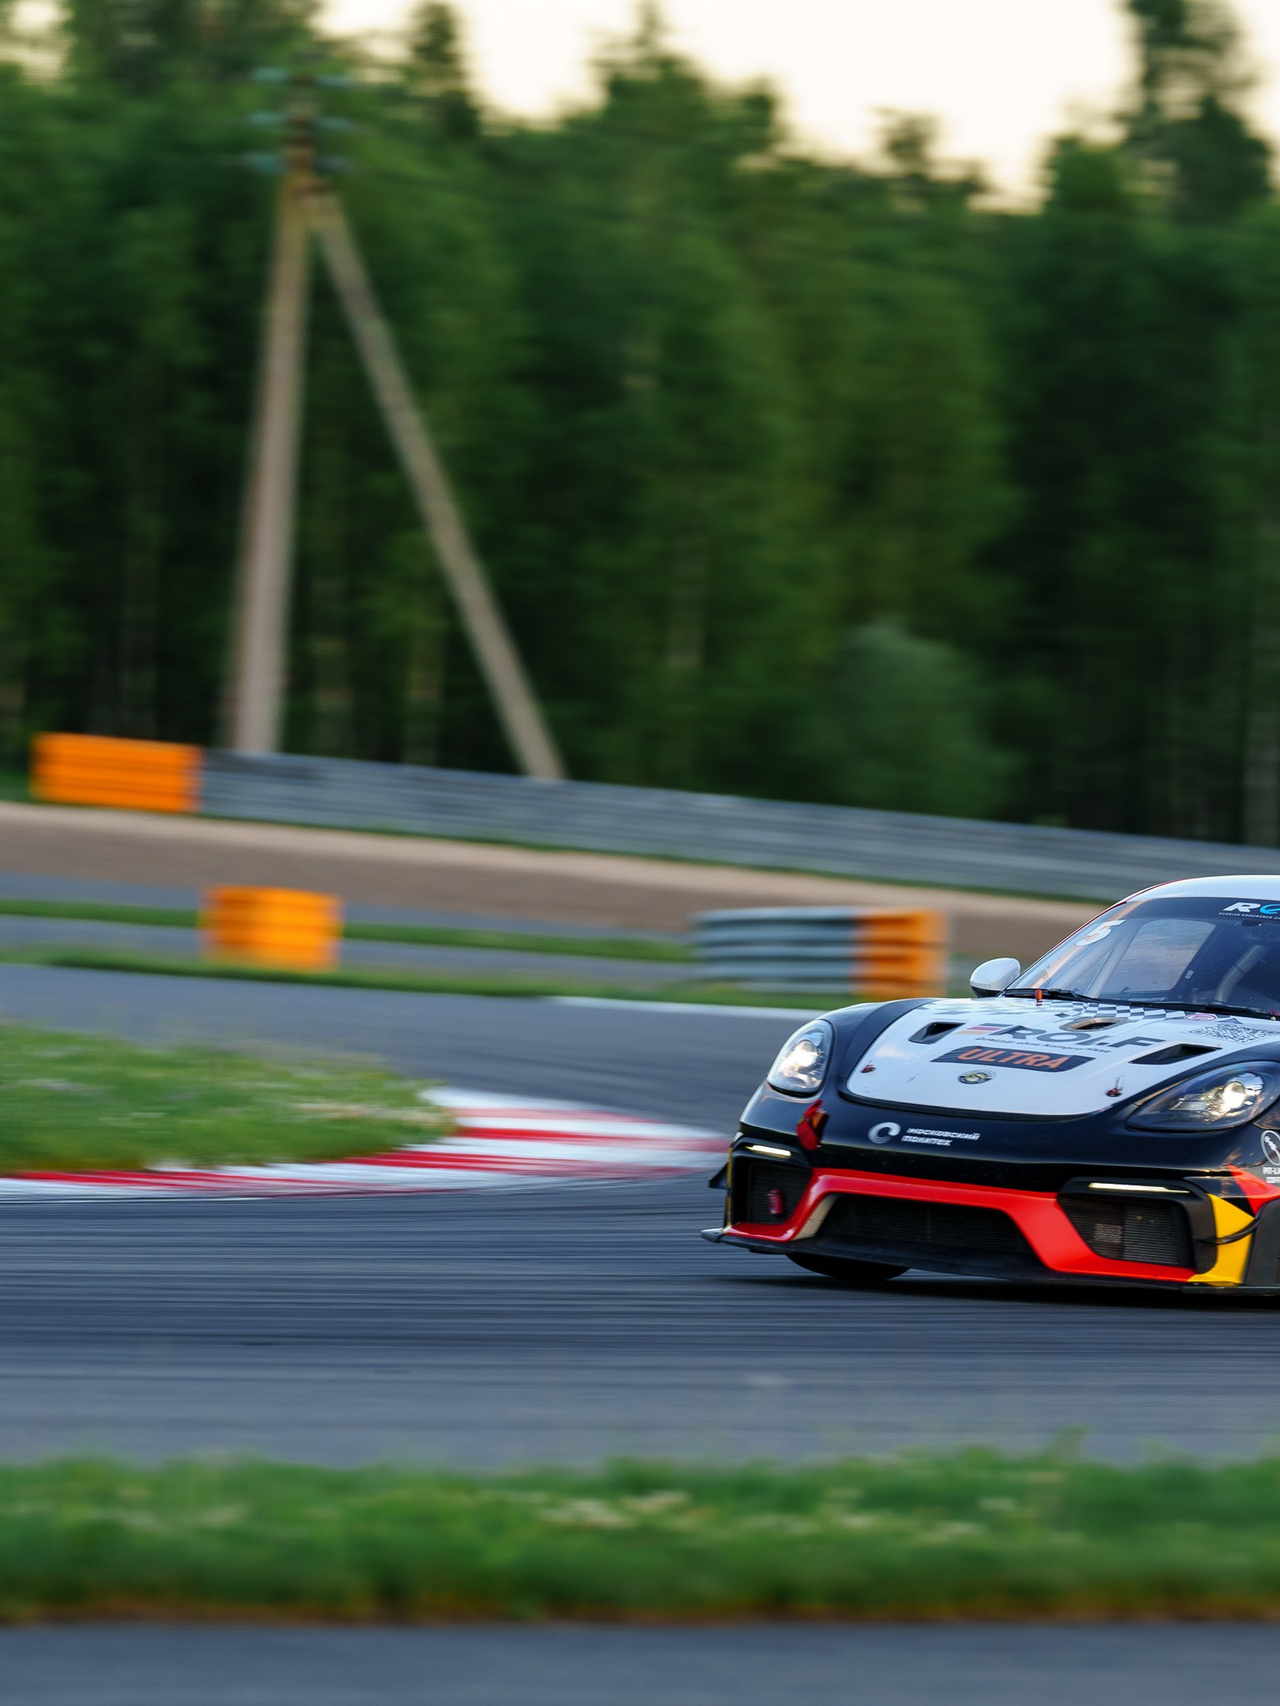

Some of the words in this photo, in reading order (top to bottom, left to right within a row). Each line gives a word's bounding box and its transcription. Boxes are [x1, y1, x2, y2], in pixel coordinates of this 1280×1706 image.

[1076, 919, 1126, 946] 5
[994, 1024, 1167, 1048] ROLF
[957, 1048, 1071, 1069] ULTRA
